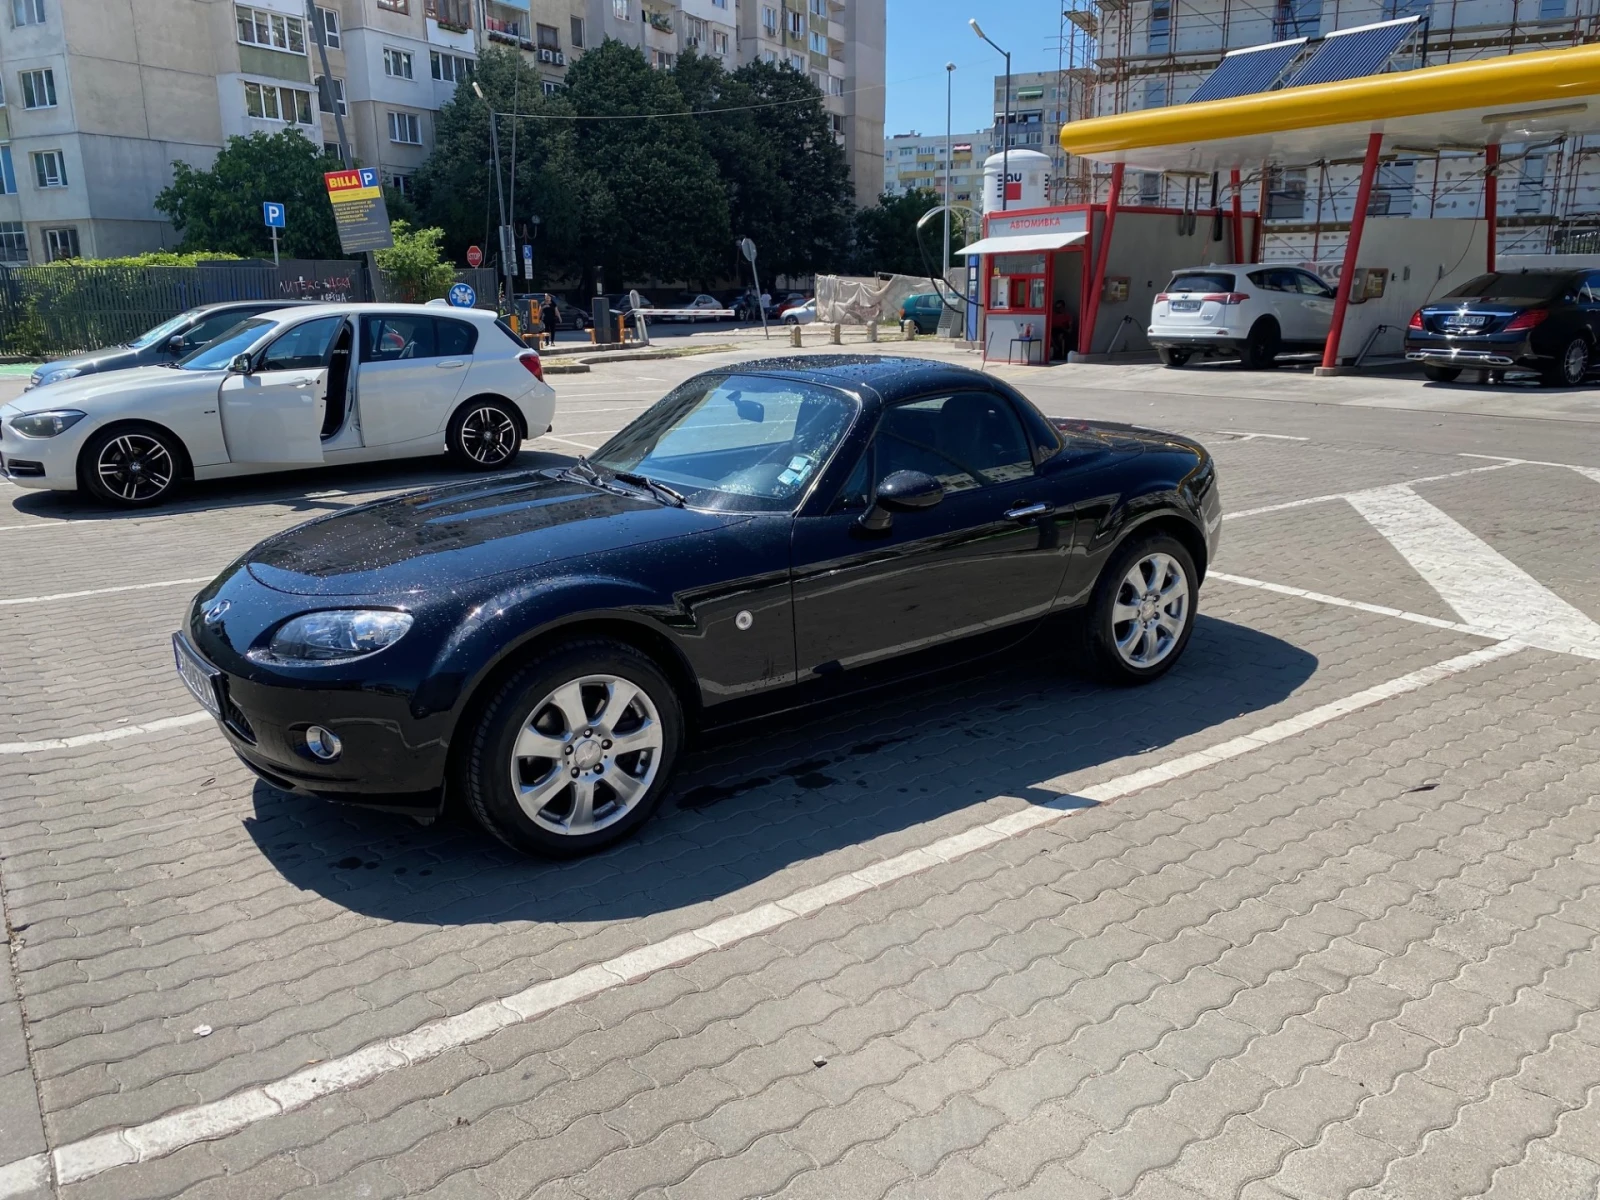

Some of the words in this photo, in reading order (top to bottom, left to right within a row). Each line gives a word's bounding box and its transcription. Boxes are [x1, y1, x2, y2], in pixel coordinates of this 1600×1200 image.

[328, 175, 359, 189] BILLA
[363, 172, 373, 185] P
[268, 205, 279, 223] P
[1010, 217, 1061, 230] АВТОМИВКА
[468, 252, 481, 260] STOP
